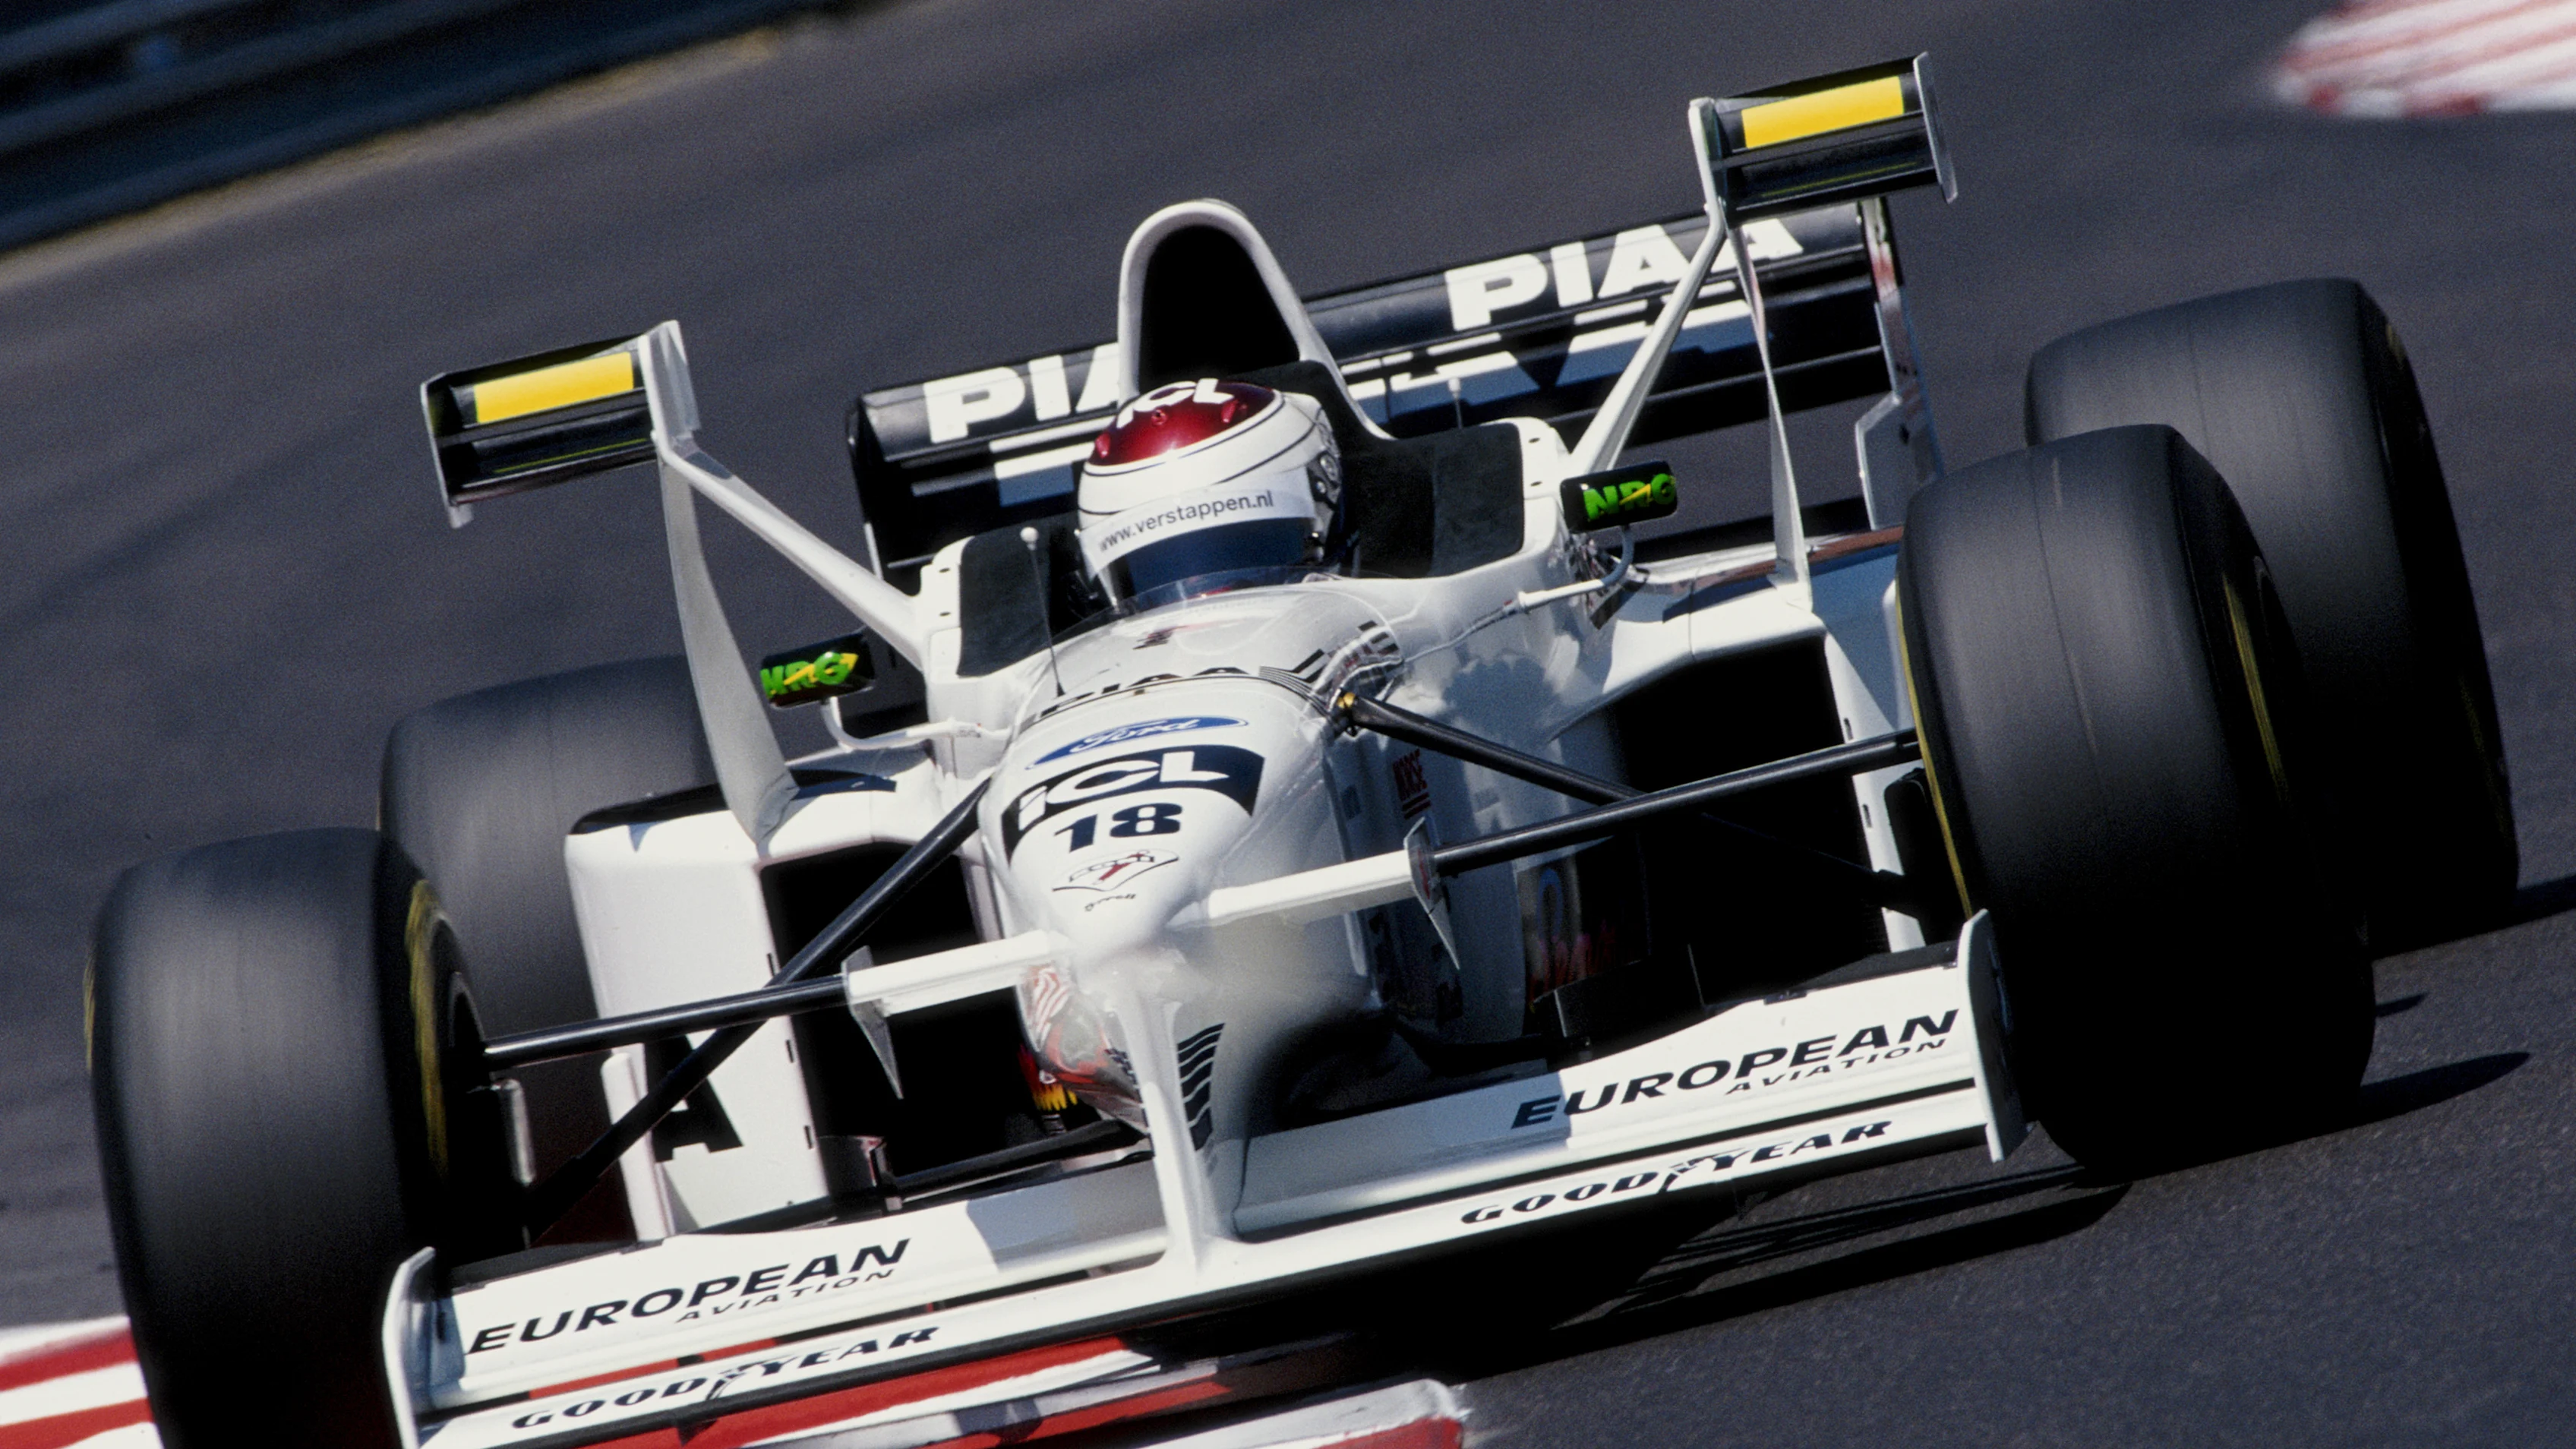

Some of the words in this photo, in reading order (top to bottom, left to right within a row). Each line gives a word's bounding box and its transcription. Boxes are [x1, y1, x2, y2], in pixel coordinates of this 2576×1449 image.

[1445, 219, 1804, 332] PIAA
[1099, 490, 1274, 551] www.verstappen.nl
[1069, 719, 1200, 753] Ford
[1018, 751, 1230, 831] ICL
[1053, 802, 1183, 854] 18
[1511, 1009, 1959, 1129] EUROPEAN
[1725, 1038, 1946, 1096] AVIATION
[465, 1238, 911, 1355] EUROPEAN
[674, 1268, 895, 1324] AVIATION
